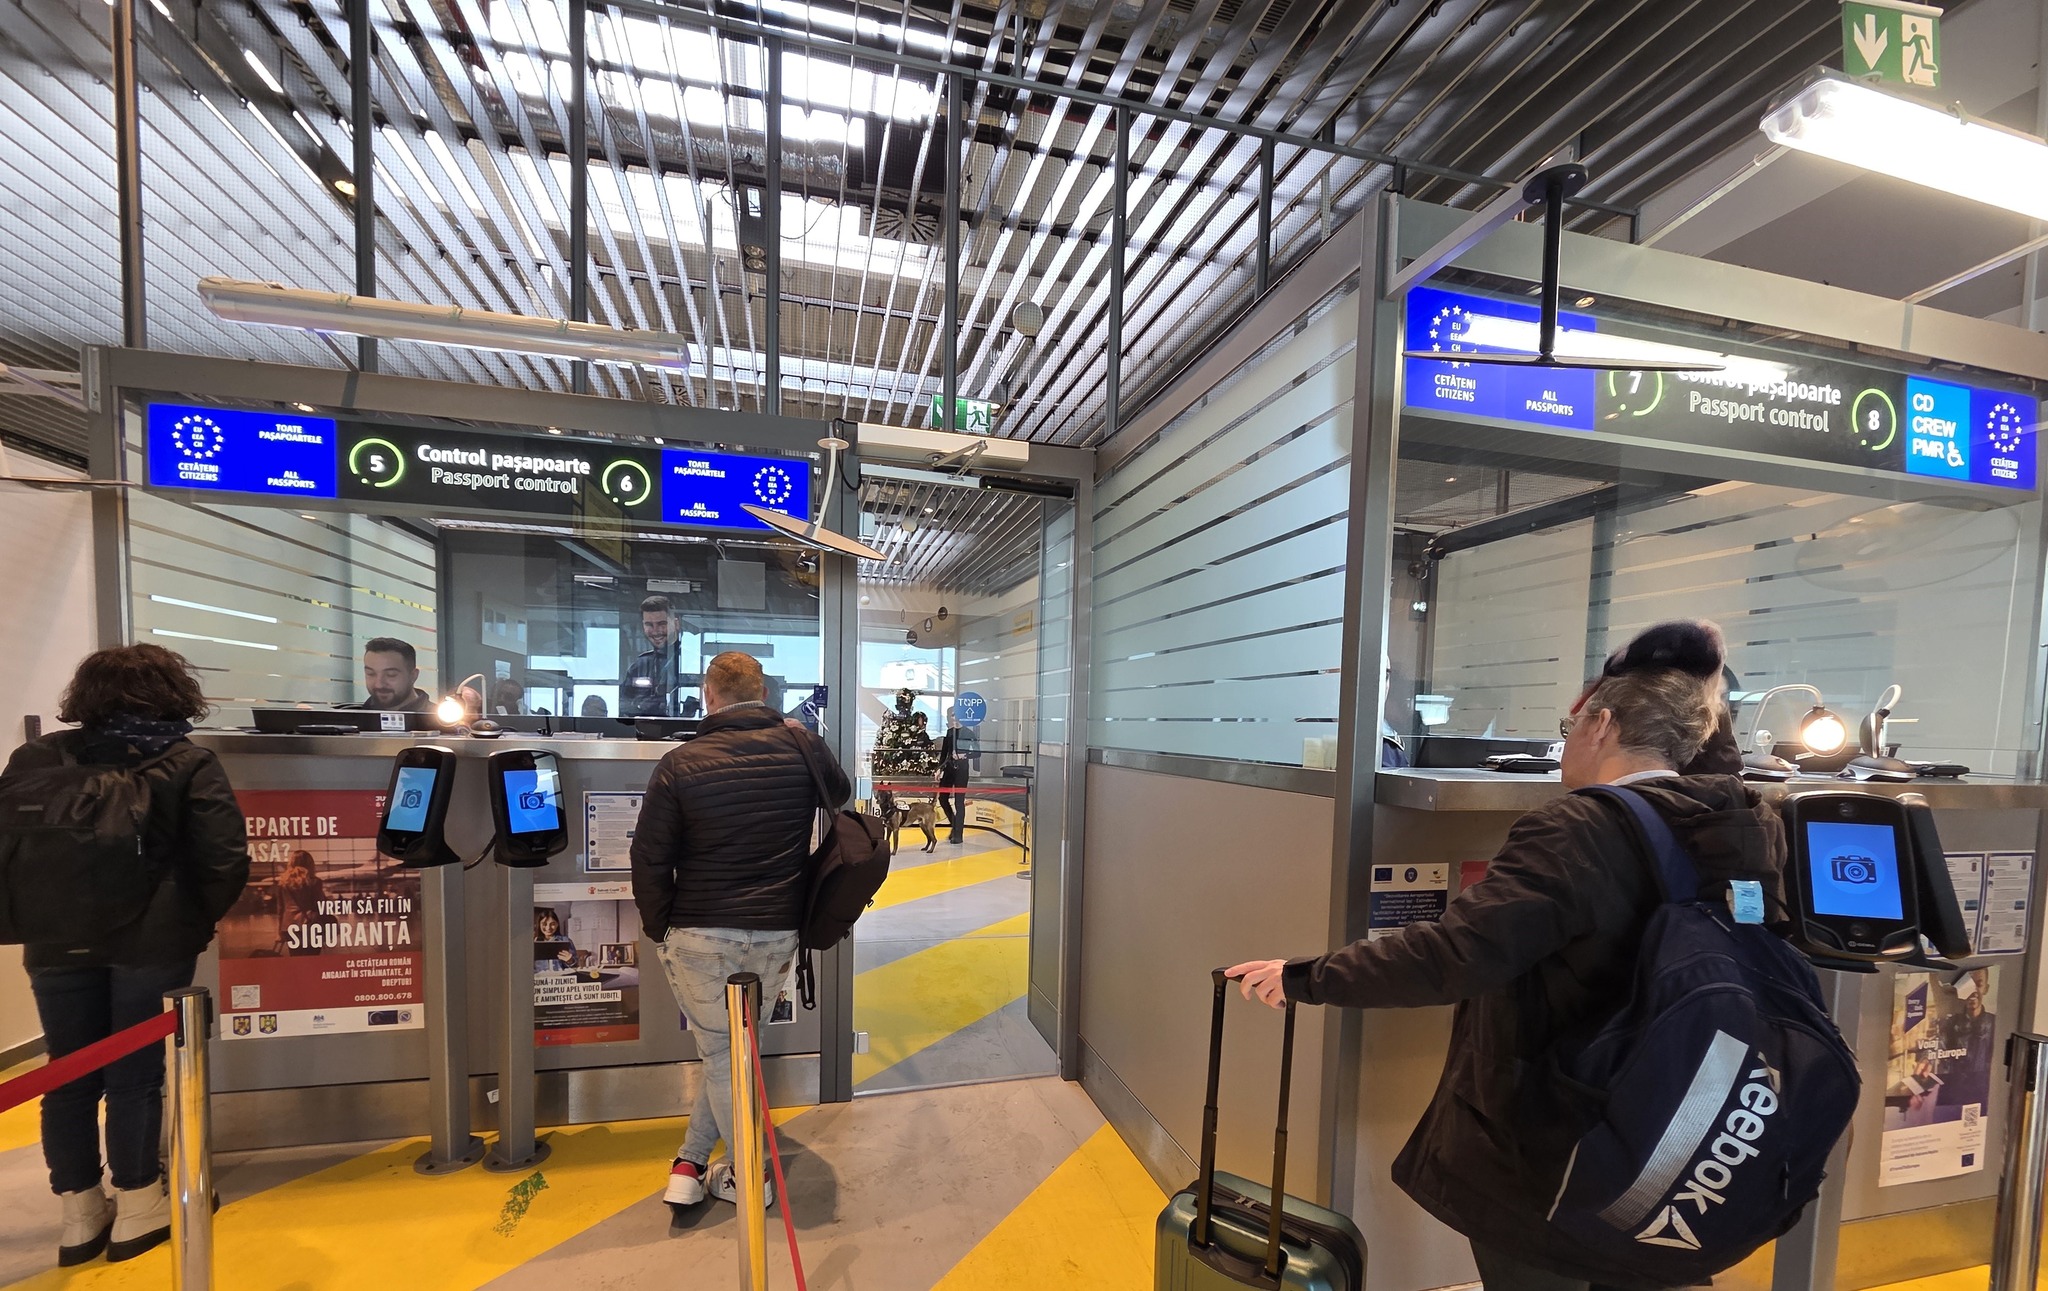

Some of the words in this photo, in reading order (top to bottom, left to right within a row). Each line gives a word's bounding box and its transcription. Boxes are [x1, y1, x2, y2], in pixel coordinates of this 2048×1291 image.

[1452, 322, 1461, 330] EU
[1451, 344, 1461, 352] CH
[1434, 374, 1476, 390] CETĂȚENI
[1629, 370, 1643, 394] 7
[1435, 388, 1475, 402] CITIZENS
[1542, 390, 1558, 402] ALL
[1748, 376, 1842, 406] pașapoarte
[1526, 400, 1574, 416] PASSPORTS
[1912, 392, 1935, 412] CD
[1689, 390, 1765, 424] Passport
[1770, 408, 1830, 433] control
[1868, 410, 1880, 430] 8
[1912, 416, 1957, 439] CREW
[276, 424, 303, 434] TOATE
[258, 431, 323, 444] PAȘAPOARTELE
[1912, 439, 1945, 459] PMR
[370, 455, 384, 472] 5
[416, 444, 487, 467] Control
[491, 453, 591, 477] pașapoarte
[688, 460, 710, 469] TOATE
[179, 471, 218, 482] CITIZENS
[283, 470, 299, 479] ALL
[430, 466, 510, 490] Passport
[514, 474, 578, 494] control
[267, 477, 316, 489] PASSPORTS
[620, 476, 632, 492] 6
[680, 508, 720, 519] PASSPORTS
[693, 502, 706, 510] ALL
[246, 816, 310, 837] EPARTE
[317, 816, 338, 836] DE
[246, 840, 291, 863] ASĂ?
[317, 899, 352, 916] VREM
[356, 896, 374, 915] SĂ
[377, 898, 394, 914] FII
[398, 896, 412, 914] ÎN
[287, 916, 412, 951] SIGURANȚĂ
[346, 960, 355, 968] CA
[389, 956, 412, 966] ROMÂN
[381, 978, 412, 987] DREPTURI
[354, 992, 412, 1002] 0800.800.678
[541, 994, 573, 1003] AMINTEȘTE
[1918, 1038, 1939, 1050] Voiaj
[1937, 1048, 1967, 1060] Europa
[1672, 1051, 1781, 1215] Reebok
